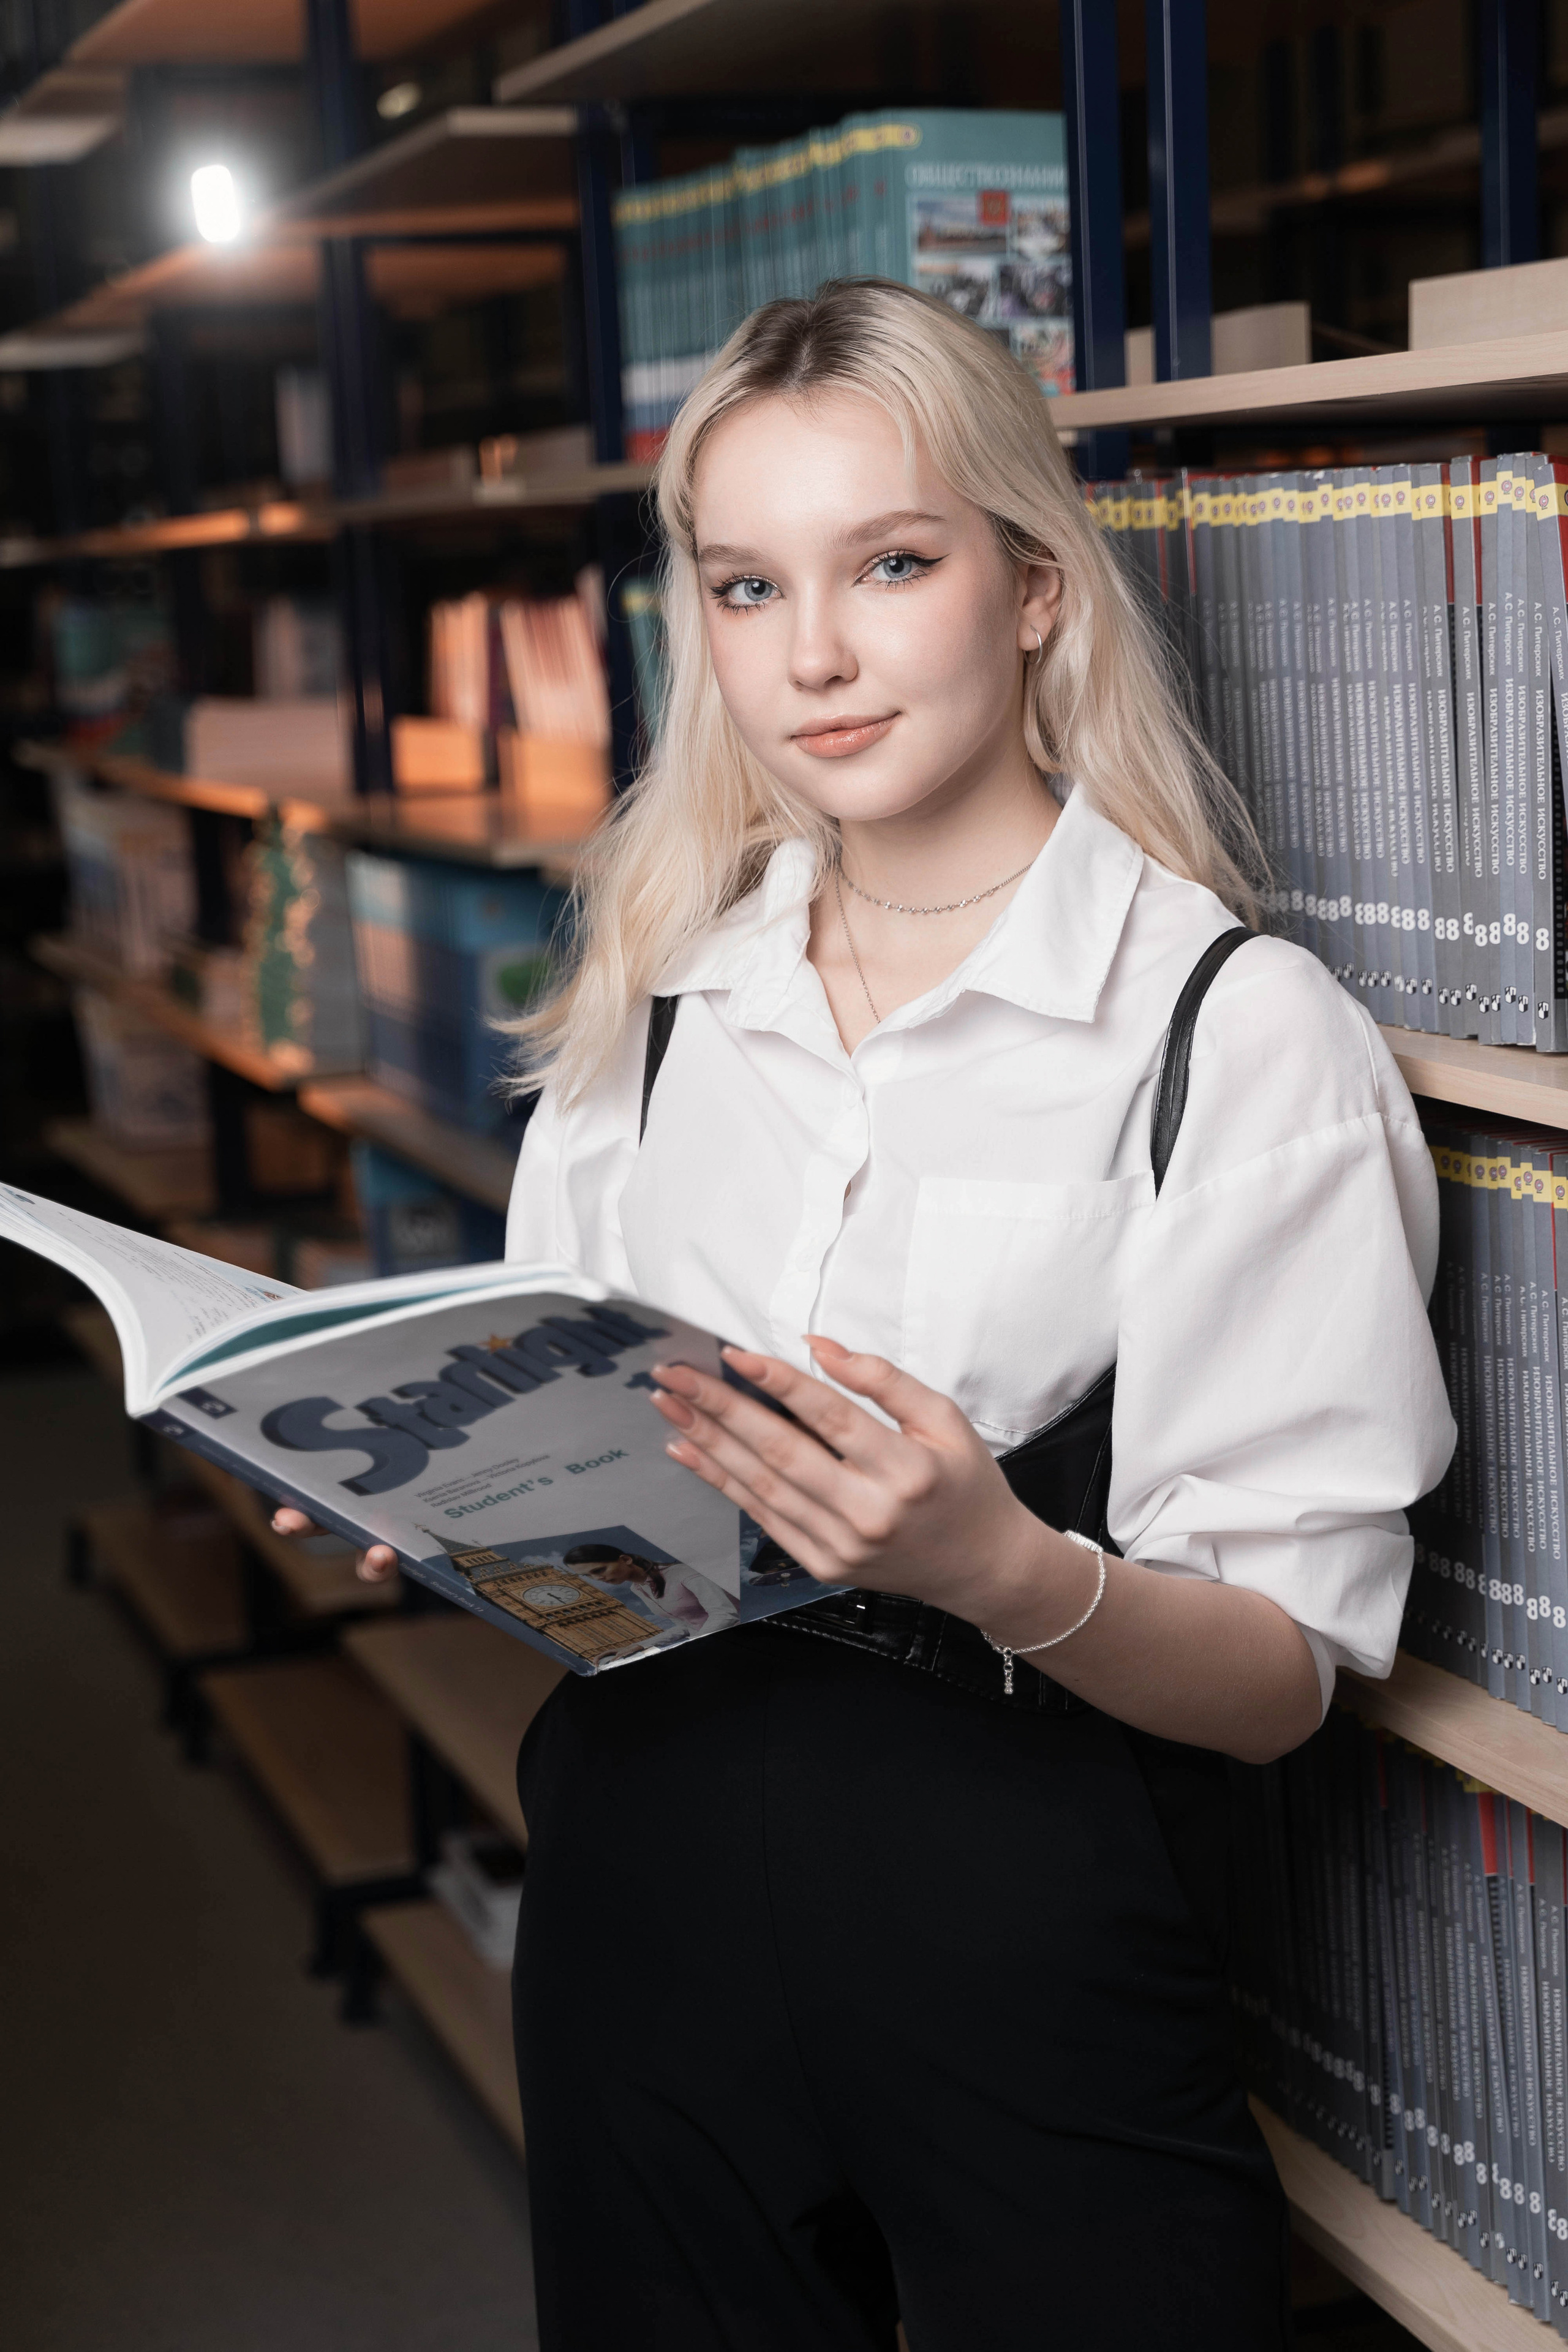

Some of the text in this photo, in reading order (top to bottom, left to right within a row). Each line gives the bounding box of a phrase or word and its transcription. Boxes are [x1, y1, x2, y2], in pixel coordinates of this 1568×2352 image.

[1555, 630, 1564, 680] Питерских
[1466, 692, 1479, 804] ИЗОБРАЗИТЕЛЬНОЕ
[1438, 688, 1455, 873] ИЗОБРАЗИТЕЛЬНОЕ ИСКУССТВО
[1489, 688, 1499, 875] ИЗОБРАЗИТЕЛЬНОЕ ИСКУССТВО
[1505, 678, 1515, 866] ИЗОБРАЗИТЕЛЬНОЕ ИСКУССТВО
[1518, 685, 1528, 874] ИЗОБРАЗИТЕЛЬНОЕ ИСКУССТВО
[1535, 690, 1547, 880] ИЗОБРАЗИТЕЛЬНОЕ ИСКУССТВО
[1472, 807, 1483, 878] ИСКУССТВО
[1327, 899, 1340, 922] 8
[1339, 894, 1352, 917] 8
[1363, 902, 1377, 925] 8
[1376, 902, 1390, 924] 8
[1401, 908, 1415, 931] 8
[1417, 908, 1430, 931] 8
[1434, 918, 1446, 940] 8
[1446, 918, 1460, 941] 8
[1463, 912, 1473, 935] 8
[1503, 913, 1516, 936] 8
[1475, 924, 1488, 947] 8
[1488, 922, 1501, 944] 8
[1517, 922, 1529, 945] 8
[1536, 928, 1550, 951] 8
[260, 1305, 671, 1496] Starlight
[564, 1448, 630, 1475] Book
[1532, 1366, 1547, 1550] ИЗОБРАЗИТЕЛЬНОЕ ИСКУССТВО
[1544, 1375, 1561, 1559] ИЗОБРАЗИТЕЛЬНОЕ ИСКУССТВО
[443, 1478, 464, 1488] Evans
[1454, 1562, 1465, 1583] 8
[1466, 1568, 1476, 1589] 8
[1488, 1579, 1501, 1600] 8
[1501, 1583, 1512, 1605] 8
[1513, 1584, 1525, 1605] 8
[457, 1596, 474, 1608] Book
[1526, 1598, 1538, 1620] 8
[1539, 1596, 1551, 1618] 8
[1553, 1606, 1566, 1628] 8
[1427, 2124, 1439, 2147] 8
[1441, 2132, 1450, 2155] 8
[1453, 2143, 1464, 2166] 8
[1464, 2140, 1476, 2163] 8
[1476, 2162, 1488, 2185] 8
[1499, 2177, 1512, 2199] 8
[1513, 2182, 1525, 2205] 8
[1529, 2191, 1541, 2214] 8
[1548, 2209, 1557, 2231] 8
[1556, 2217, 1568, 2241] 8
